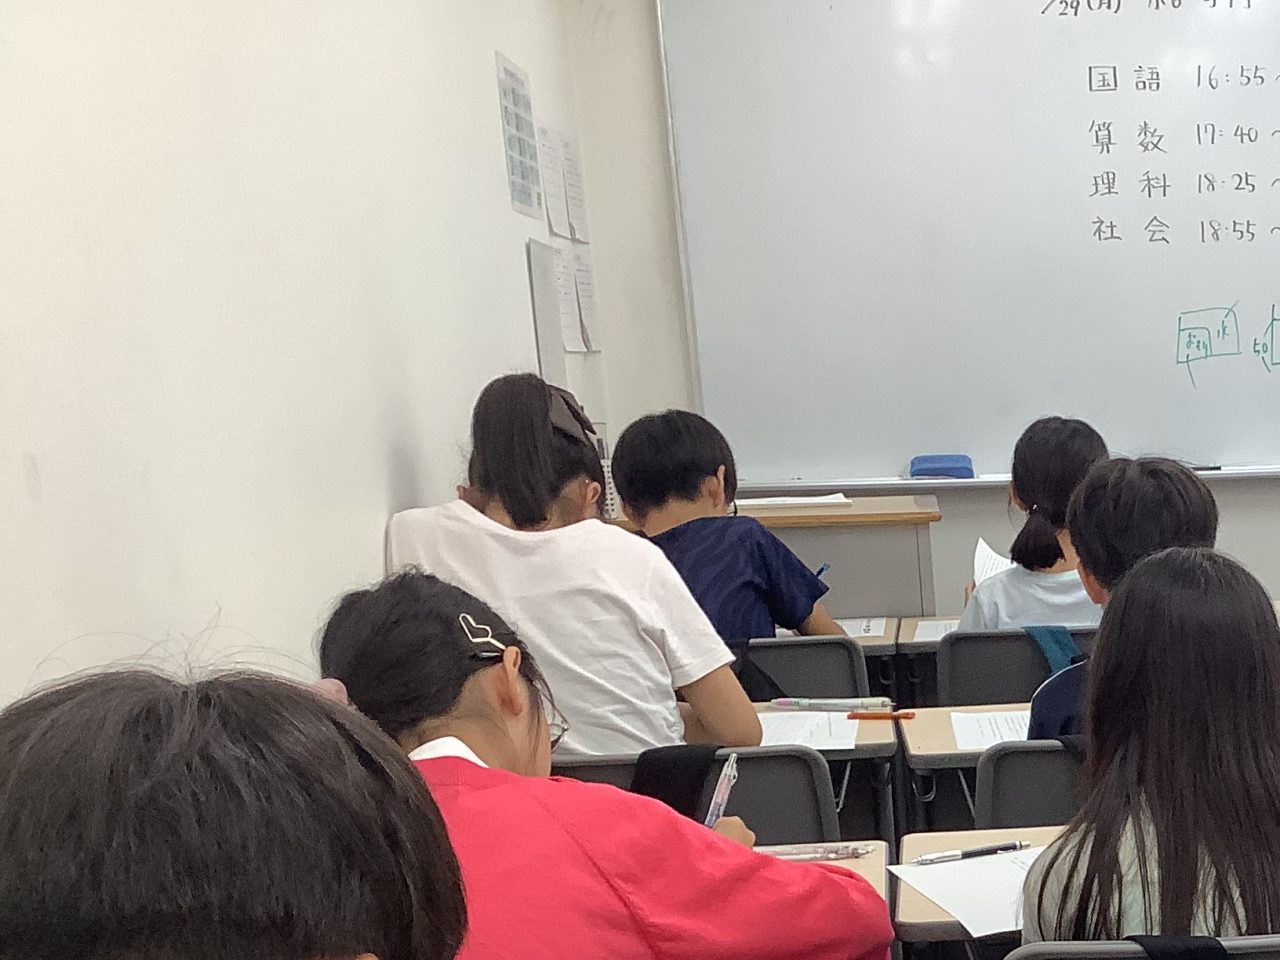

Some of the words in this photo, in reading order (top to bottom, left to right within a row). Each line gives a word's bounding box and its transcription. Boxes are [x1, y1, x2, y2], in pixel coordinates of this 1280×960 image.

[1088, 65, 1161, 92] 国語
[1088, 119, 1168, 154] 算数
[1089, 170, 1172, 198] 理科
[1091, 215, 1171, 245] 社会
